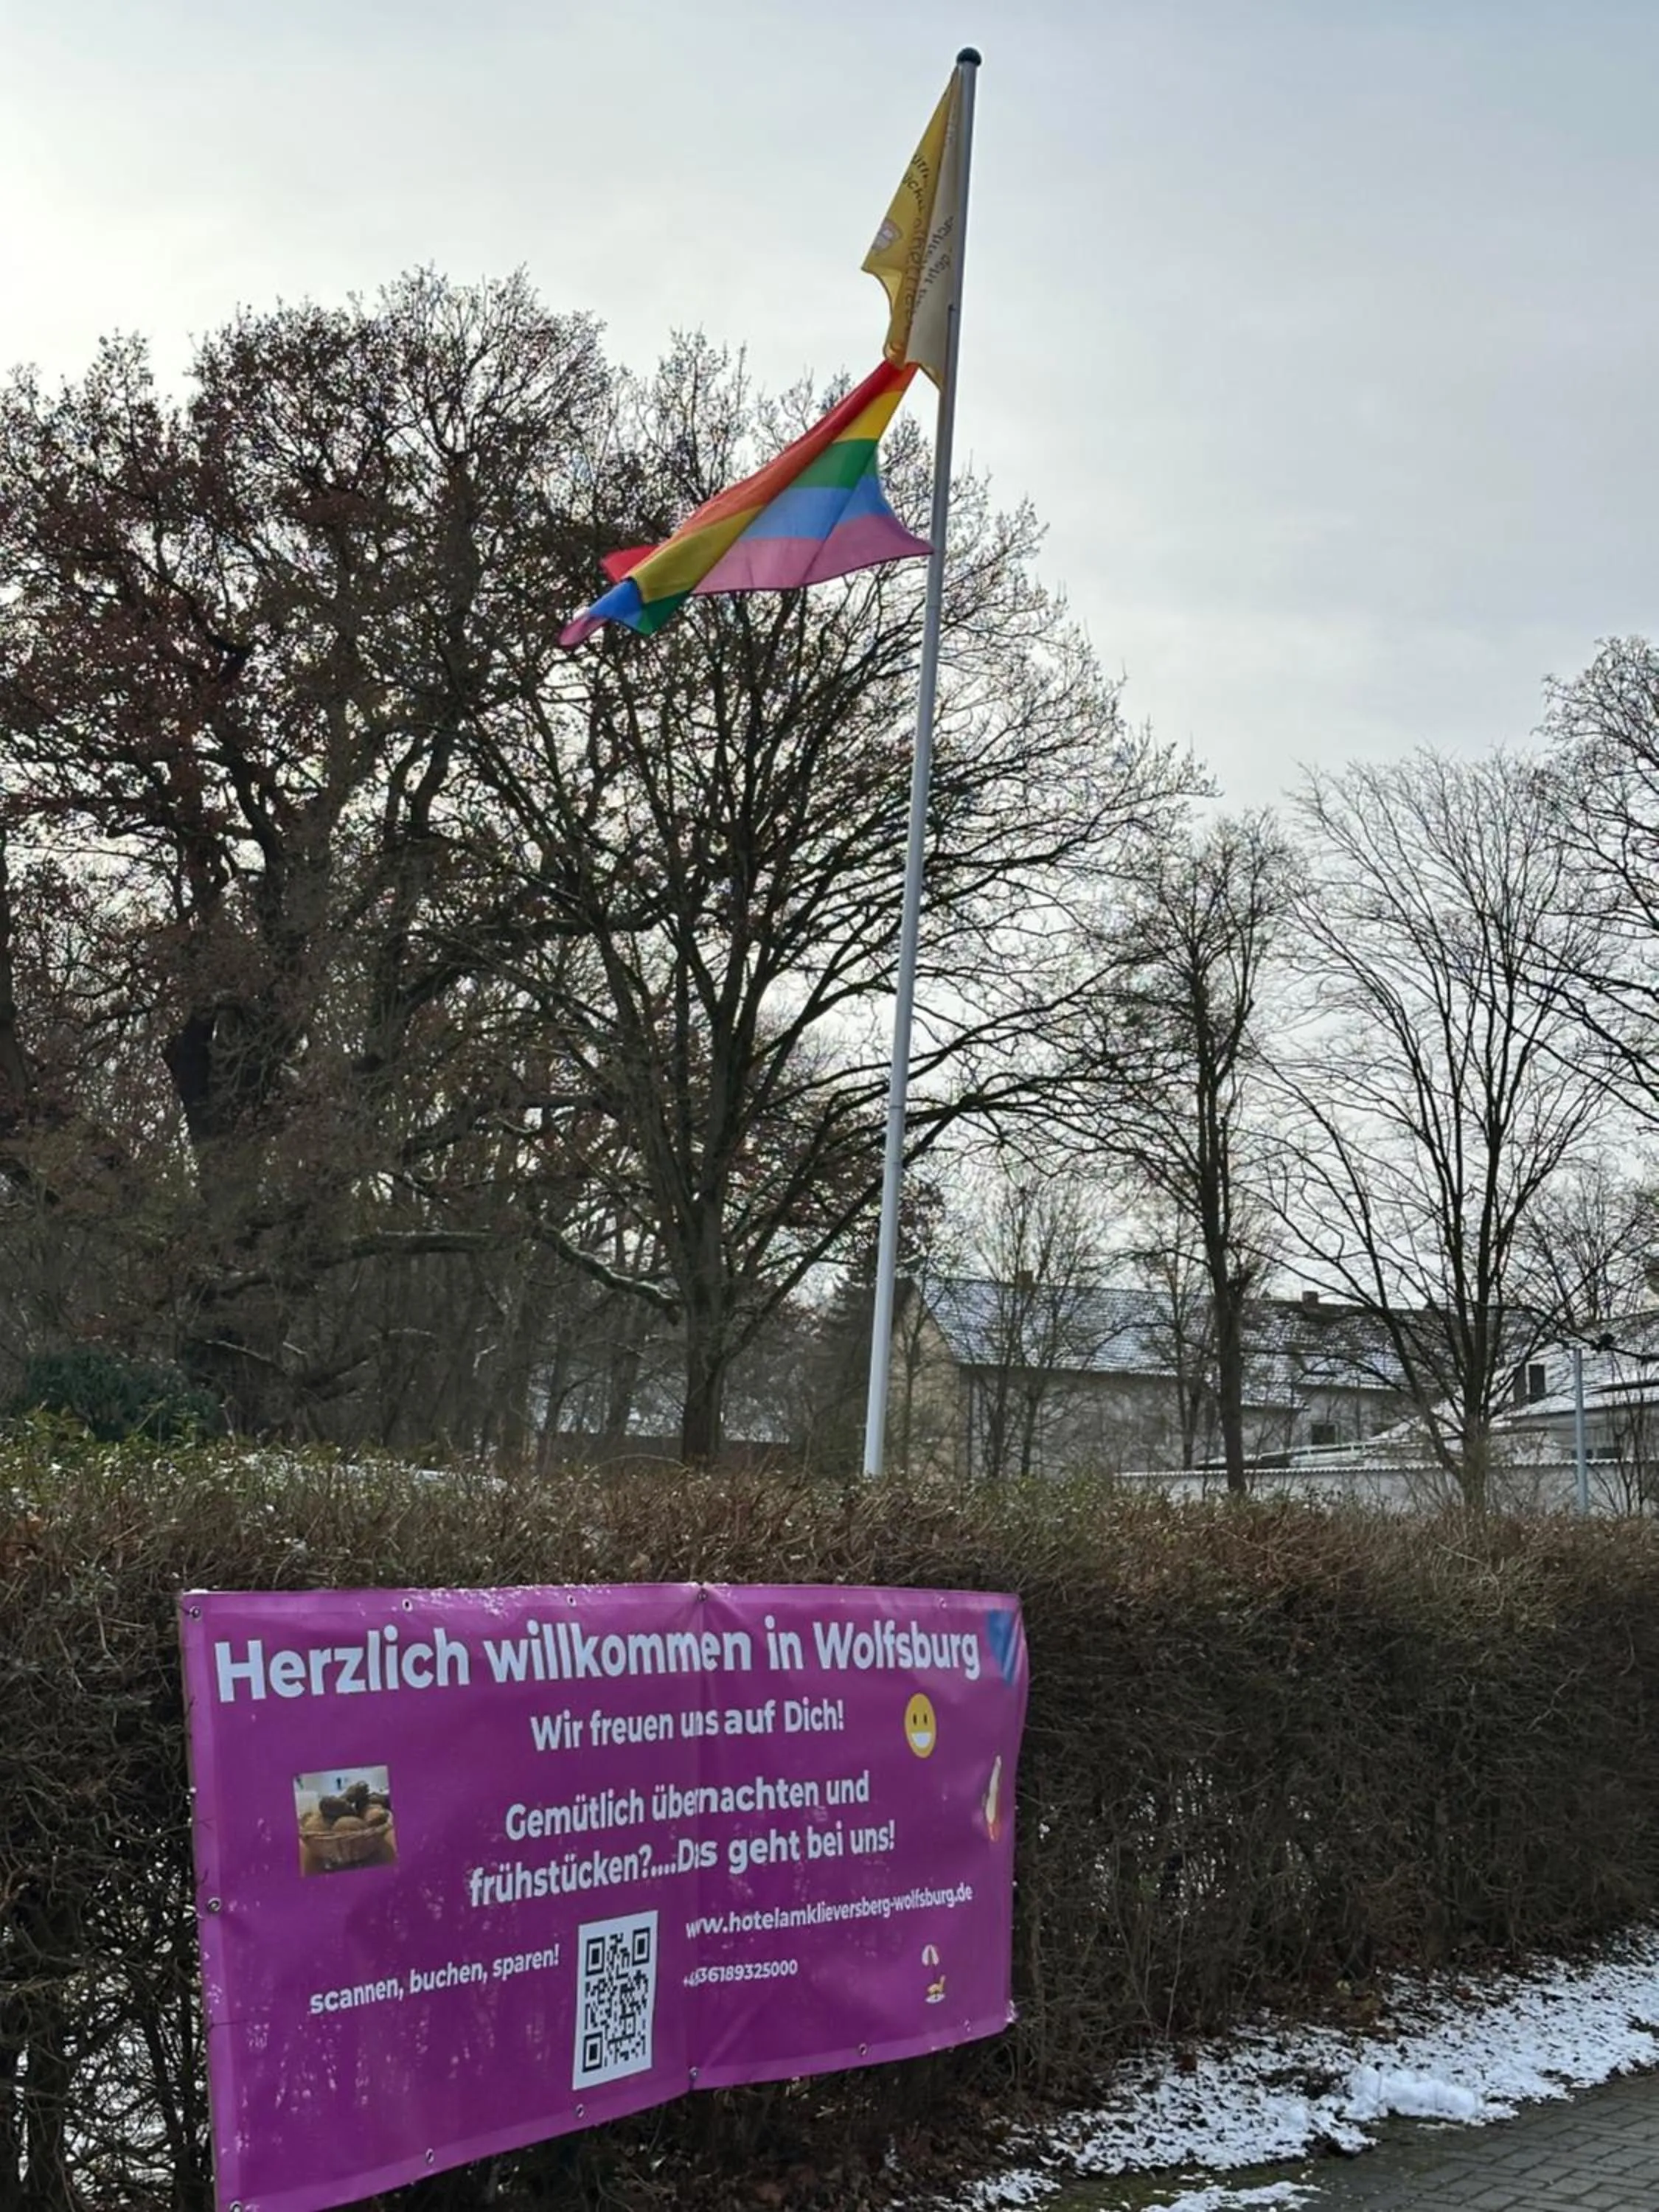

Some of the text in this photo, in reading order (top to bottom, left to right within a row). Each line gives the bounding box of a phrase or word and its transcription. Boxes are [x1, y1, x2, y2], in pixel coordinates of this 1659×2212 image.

[215, 1615, 981, 1703] Herzlich willkommen in Wolfsburg
[530, 1697, 844, 1751] Wir freuen uns auf Dich!
[505, 1770, 869, 1841] Gemütlich übernachten und
[728, 1829, 801, 1875] geht
[807, 1820, 844, 1859] bei
[850, 1820, 894, 1854] uns!
[310, 1943, 560, 2014] scannen, buchen, sparen!
